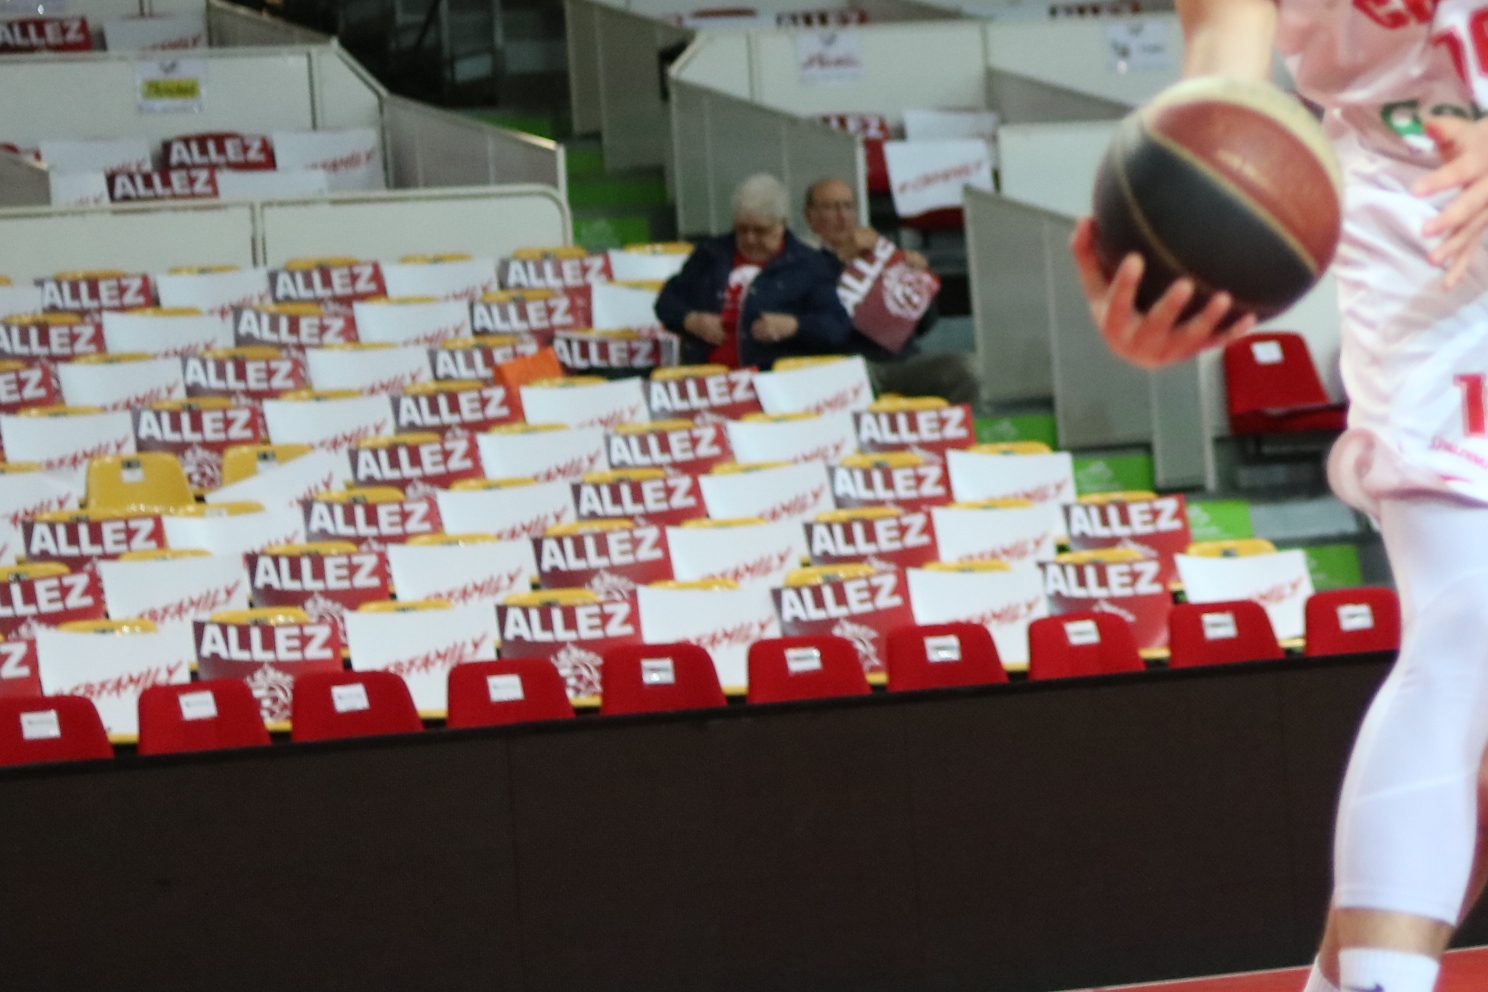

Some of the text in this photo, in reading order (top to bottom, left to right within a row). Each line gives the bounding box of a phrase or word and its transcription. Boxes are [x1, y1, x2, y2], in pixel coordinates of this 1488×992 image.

[168, 137, 267, 168] ALLEZ
[112, 170, 214, 199] ALLEZ
[276, 263, 378, 299] ALLEZ
[507, 254, 608, 289] ALLEZ
[42, 277, 145, 308] ALLEZ
[238, 309, 346, 345] ALLEZ
[473, 297, 573, 333] ALLEZ
[553, 336, 656, 369] ALLEZ
[185, 357, 295, 391] ALLEZ
[650, 370, 756, 411] ALLEZ
[138, 408, 253, 443] ALLEZ
[397, 387, 511, 428] ALLEZ
[859, 406, 968, 444] ALLEZ
[355, 441, 473, 482] ALLEZ
[608, 427, 721, 468] ALLEZ
[579, 475, 696, 516] ALLEZ
[833, 465, 945, 503] ALLEZ
[309, 502, 432, 537] ALLEZ
[811, 513, 930, 556] ALLEZ
[1070, 497, 1184, 538] ALLEZ
[29, 518, 157, 557] ALLEZ
[540, 525, 663, 572] ALLEZ
[253, 554, 381, 591] ALLEZ
[1044, 561, 1164, 598] ALLEZ
[0, 572, 94, 618] LEZ
[781, 574, 903, 622] ALLEZ
[503, 602, 634, 642] ALLEZ
[200, 624, 334, 662] ALLEZ
